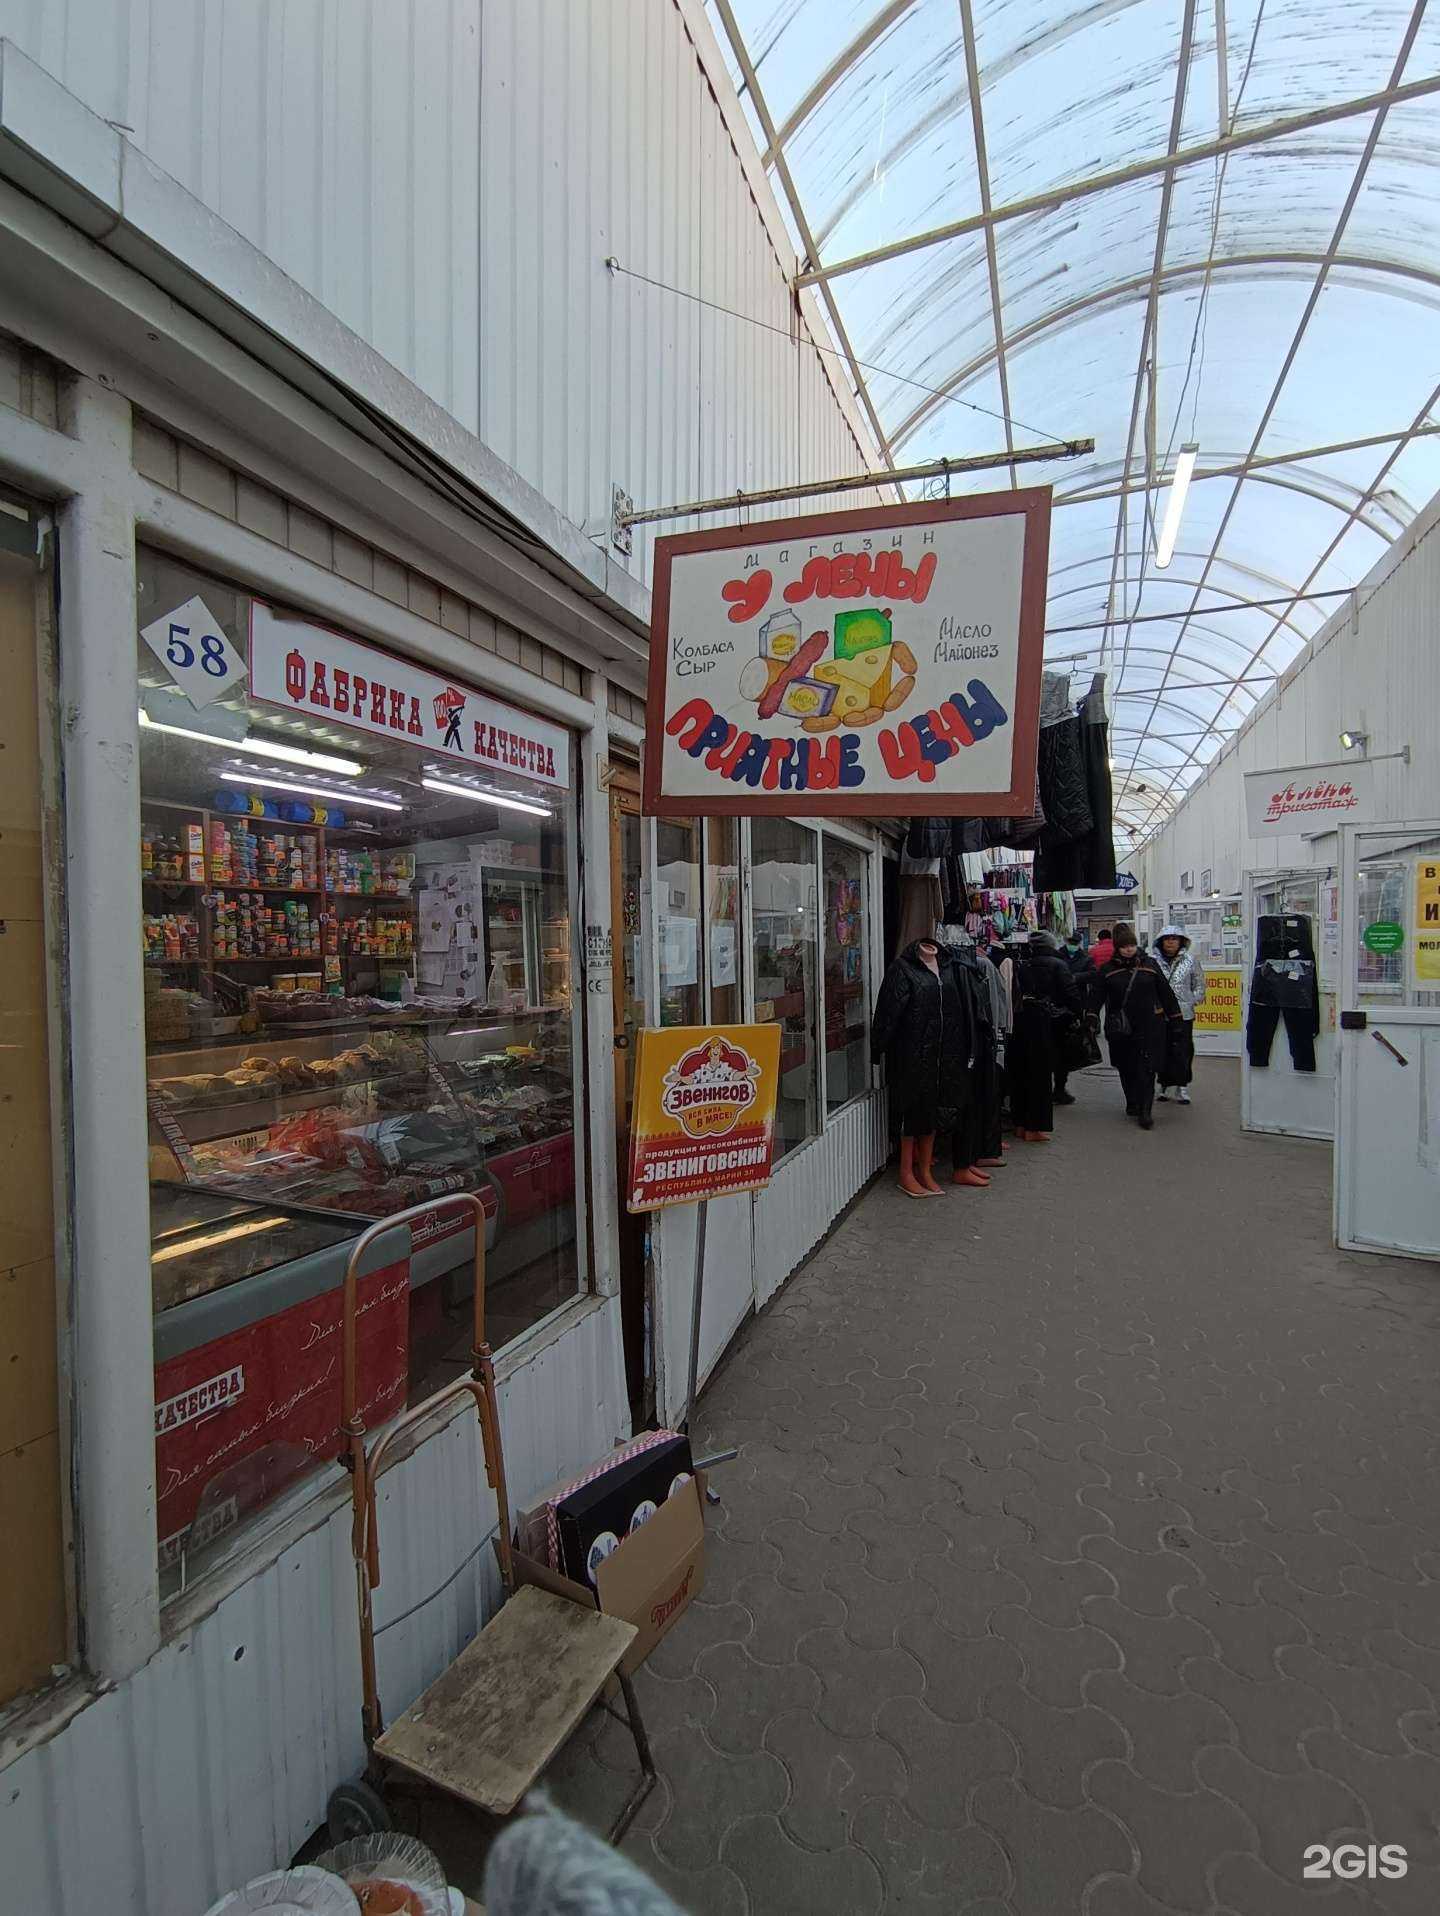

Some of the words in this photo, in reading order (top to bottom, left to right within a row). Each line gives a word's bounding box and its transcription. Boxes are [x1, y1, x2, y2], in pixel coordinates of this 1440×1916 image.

[722, 569, 773, 623] У
[783, 550, 938, 604] ЛЕНЫ
[166, 622, 229, 678] 58
[284, 648, 424, 737] ФАБРИКА
[473, 720, 557, 778] КАЧЕСТВА
[666, 698, 865, 790] ПРИЯТНЫЕ
[877, 679, 1009, 783] ЦЕНЫ
[1206, 977, 1237, 989] ФЕТЫ
[1211, 995, 1239, 1007] КОФЕ
[696, 1118, 704, 1129] В
[643, 1142, 768, 1183] ЗВЕНИГОВСКИЙ
